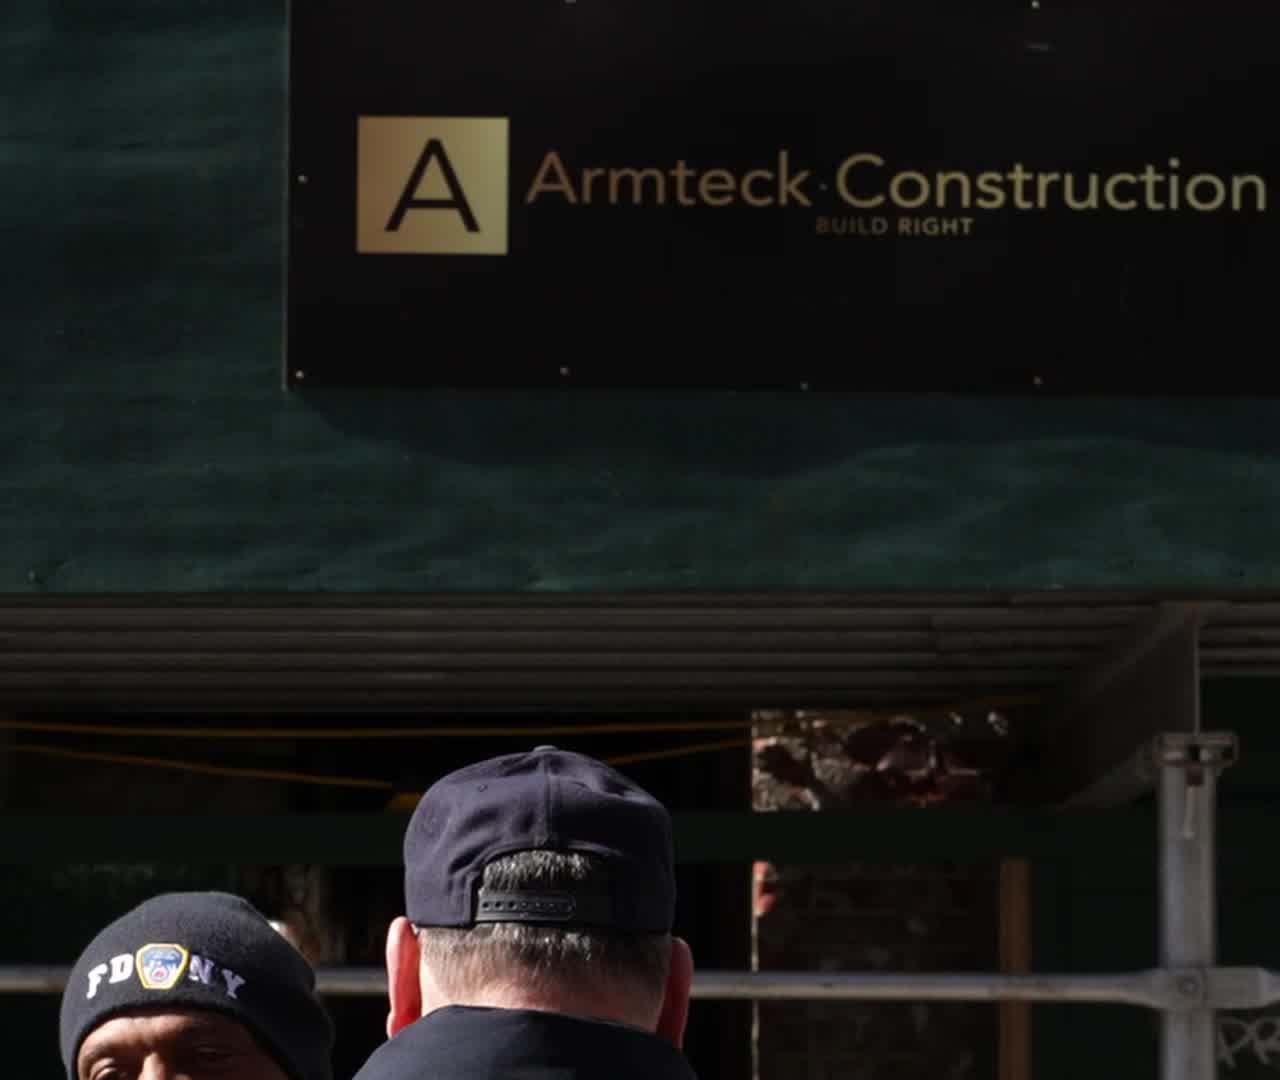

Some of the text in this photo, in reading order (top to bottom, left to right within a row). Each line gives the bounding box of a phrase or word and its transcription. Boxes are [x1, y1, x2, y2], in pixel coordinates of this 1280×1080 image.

[525, 149, 1268, 214] Armteck Construction
[815, 215, 976, 238] BUILD RIGHT
